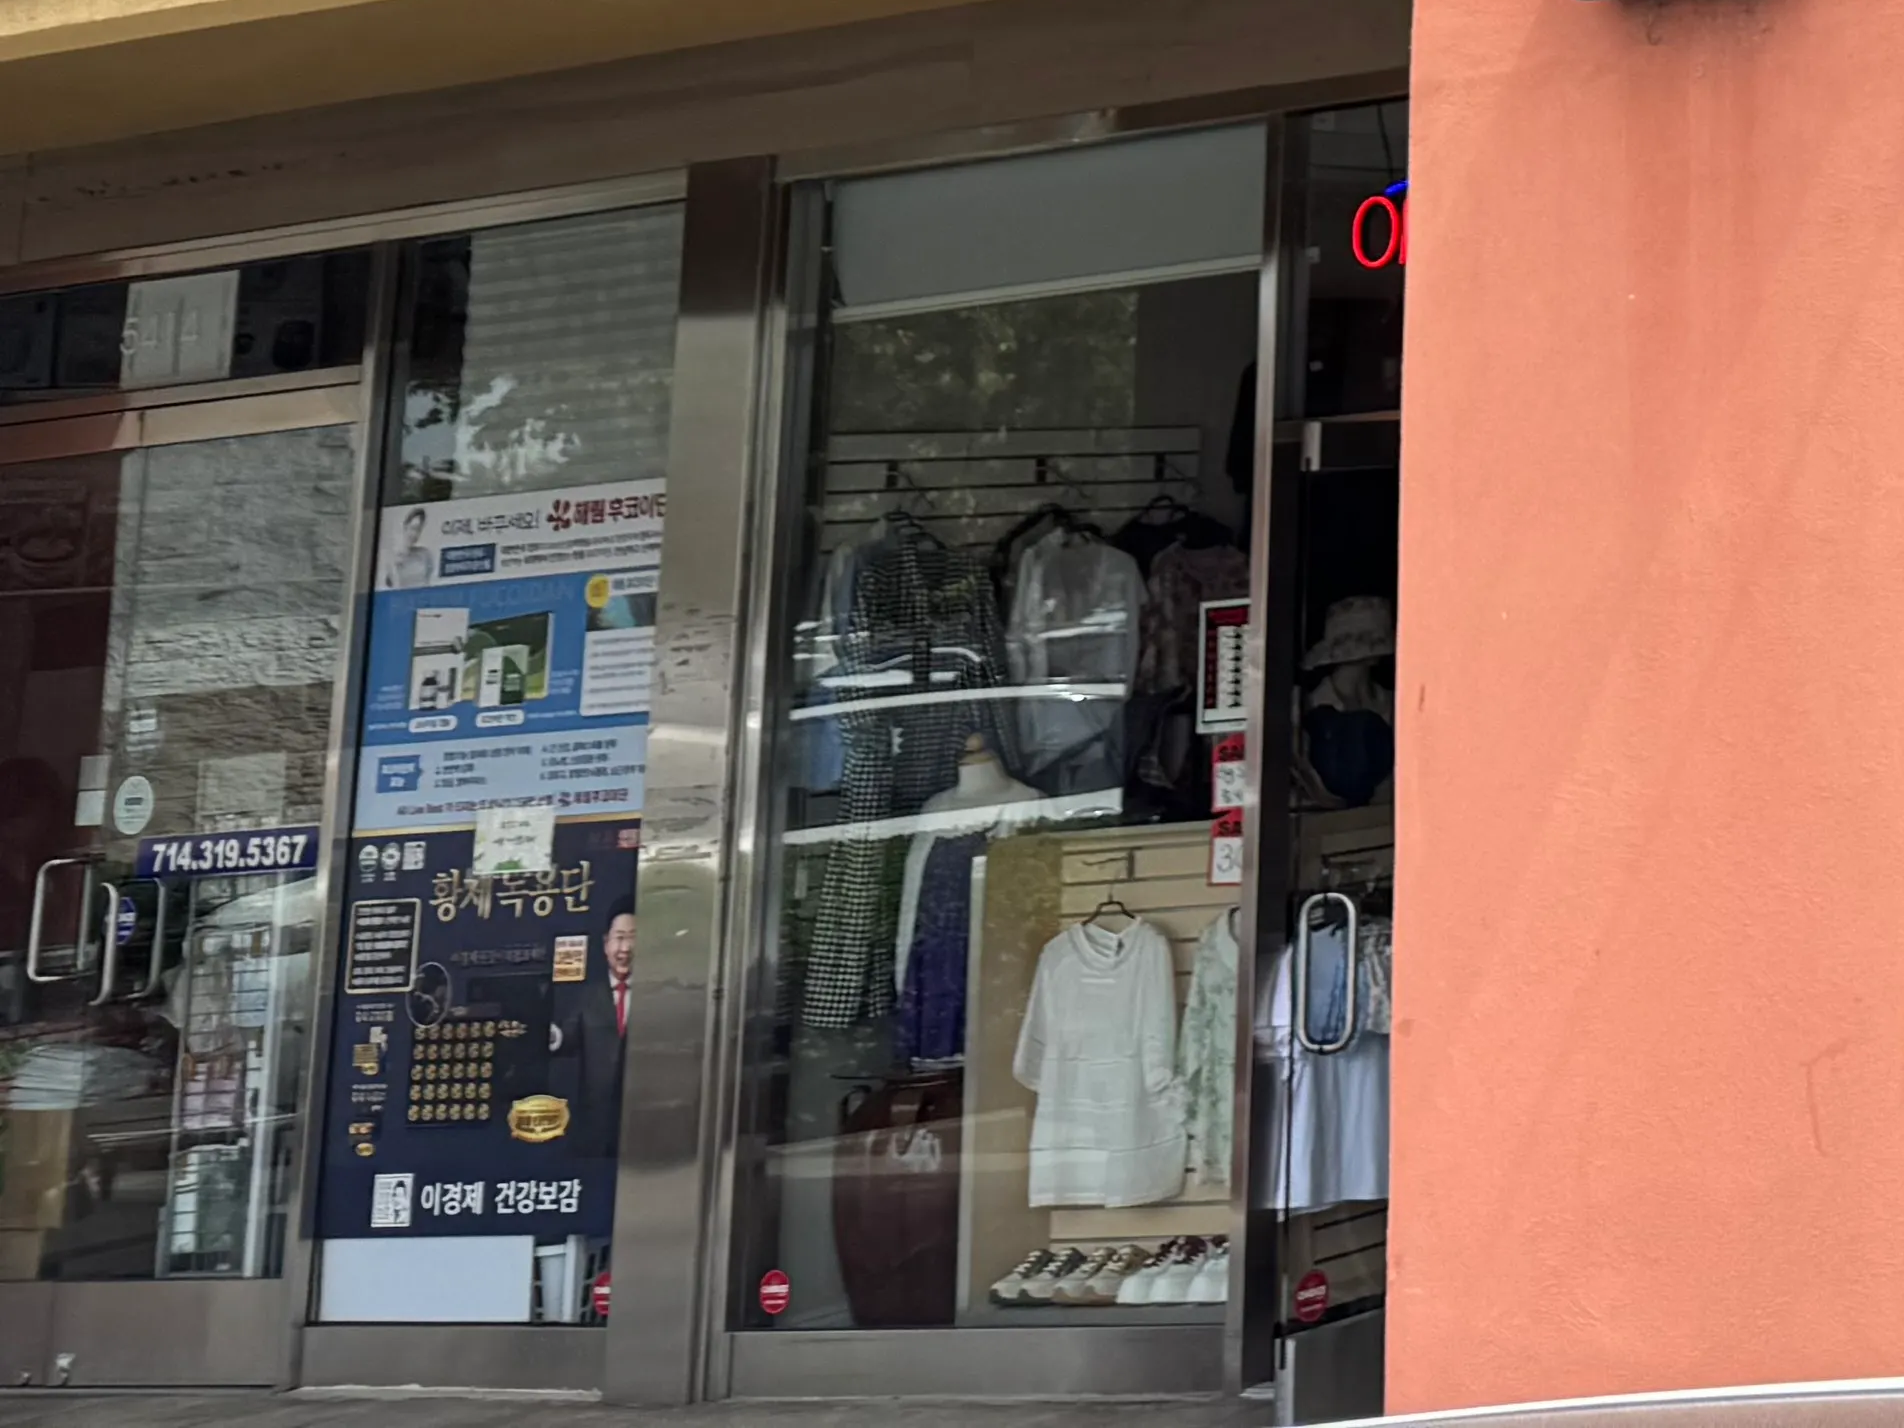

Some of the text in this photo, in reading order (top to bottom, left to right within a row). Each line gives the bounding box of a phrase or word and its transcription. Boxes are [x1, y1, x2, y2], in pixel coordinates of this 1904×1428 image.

[1351, 195, 1407, 268] O
[151, 834, 308, 873] 714.319.5367
[420, 1178, 583, 1217] 이경제 건강보감
